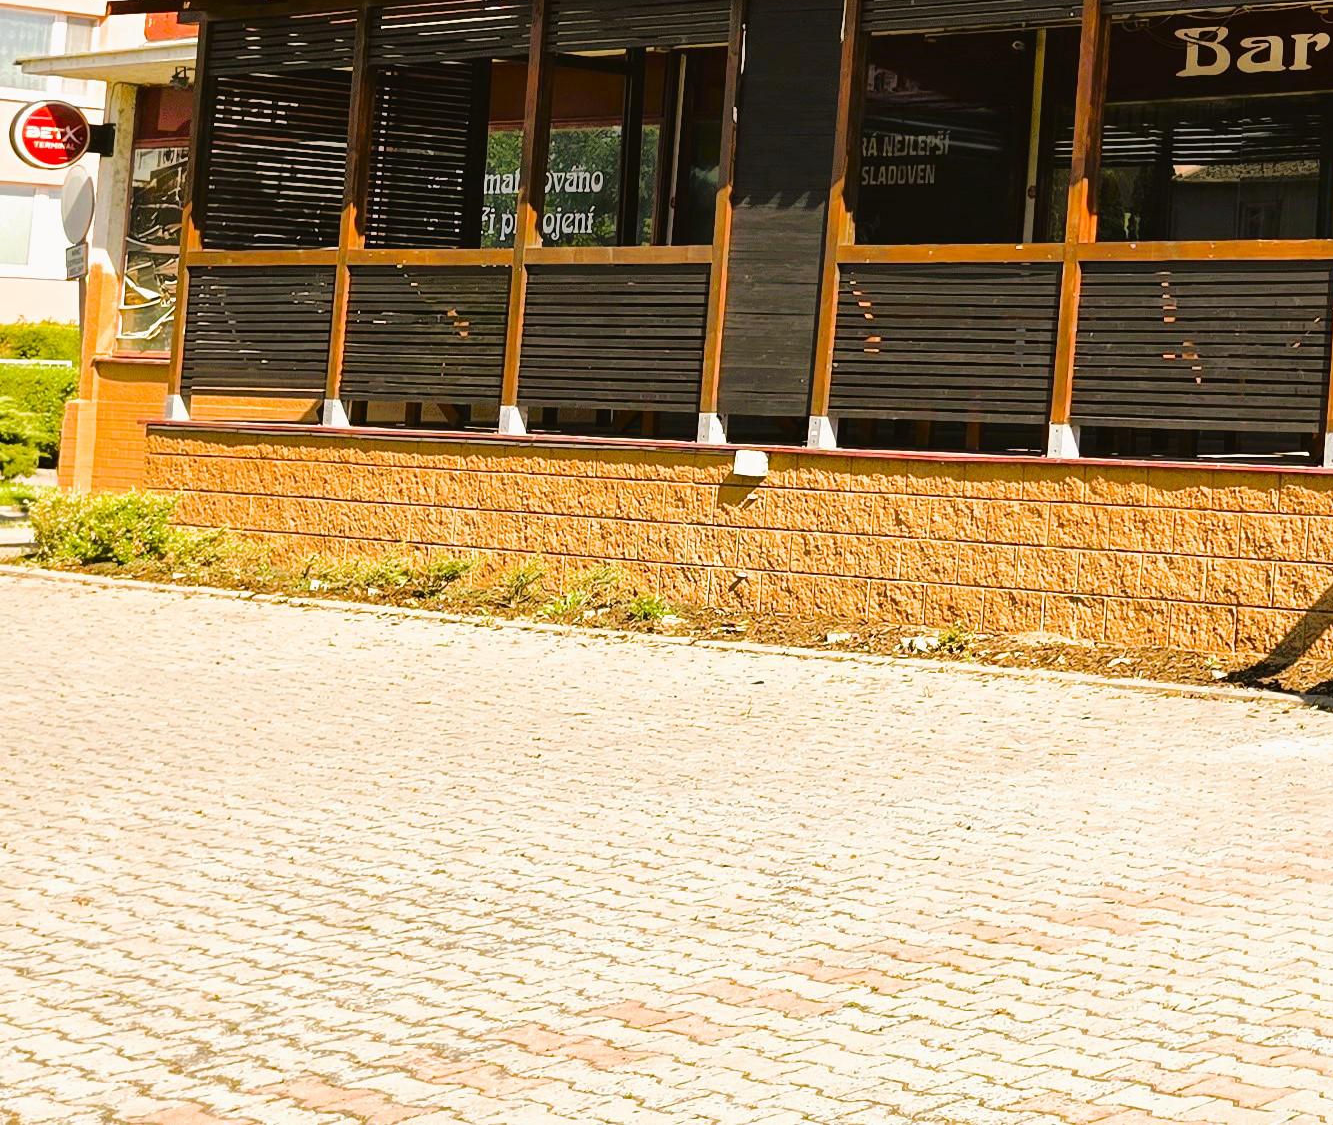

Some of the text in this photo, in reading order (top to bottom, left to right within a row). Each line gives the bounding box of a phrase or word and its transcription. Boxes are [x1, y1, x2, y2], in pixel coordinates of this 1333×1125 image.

[1174, 26, 1331, 77] Bar
[882, 130, 951, 157] NEJLEPŠÍ
[861, 164, 936, 186] SLADOVEN
